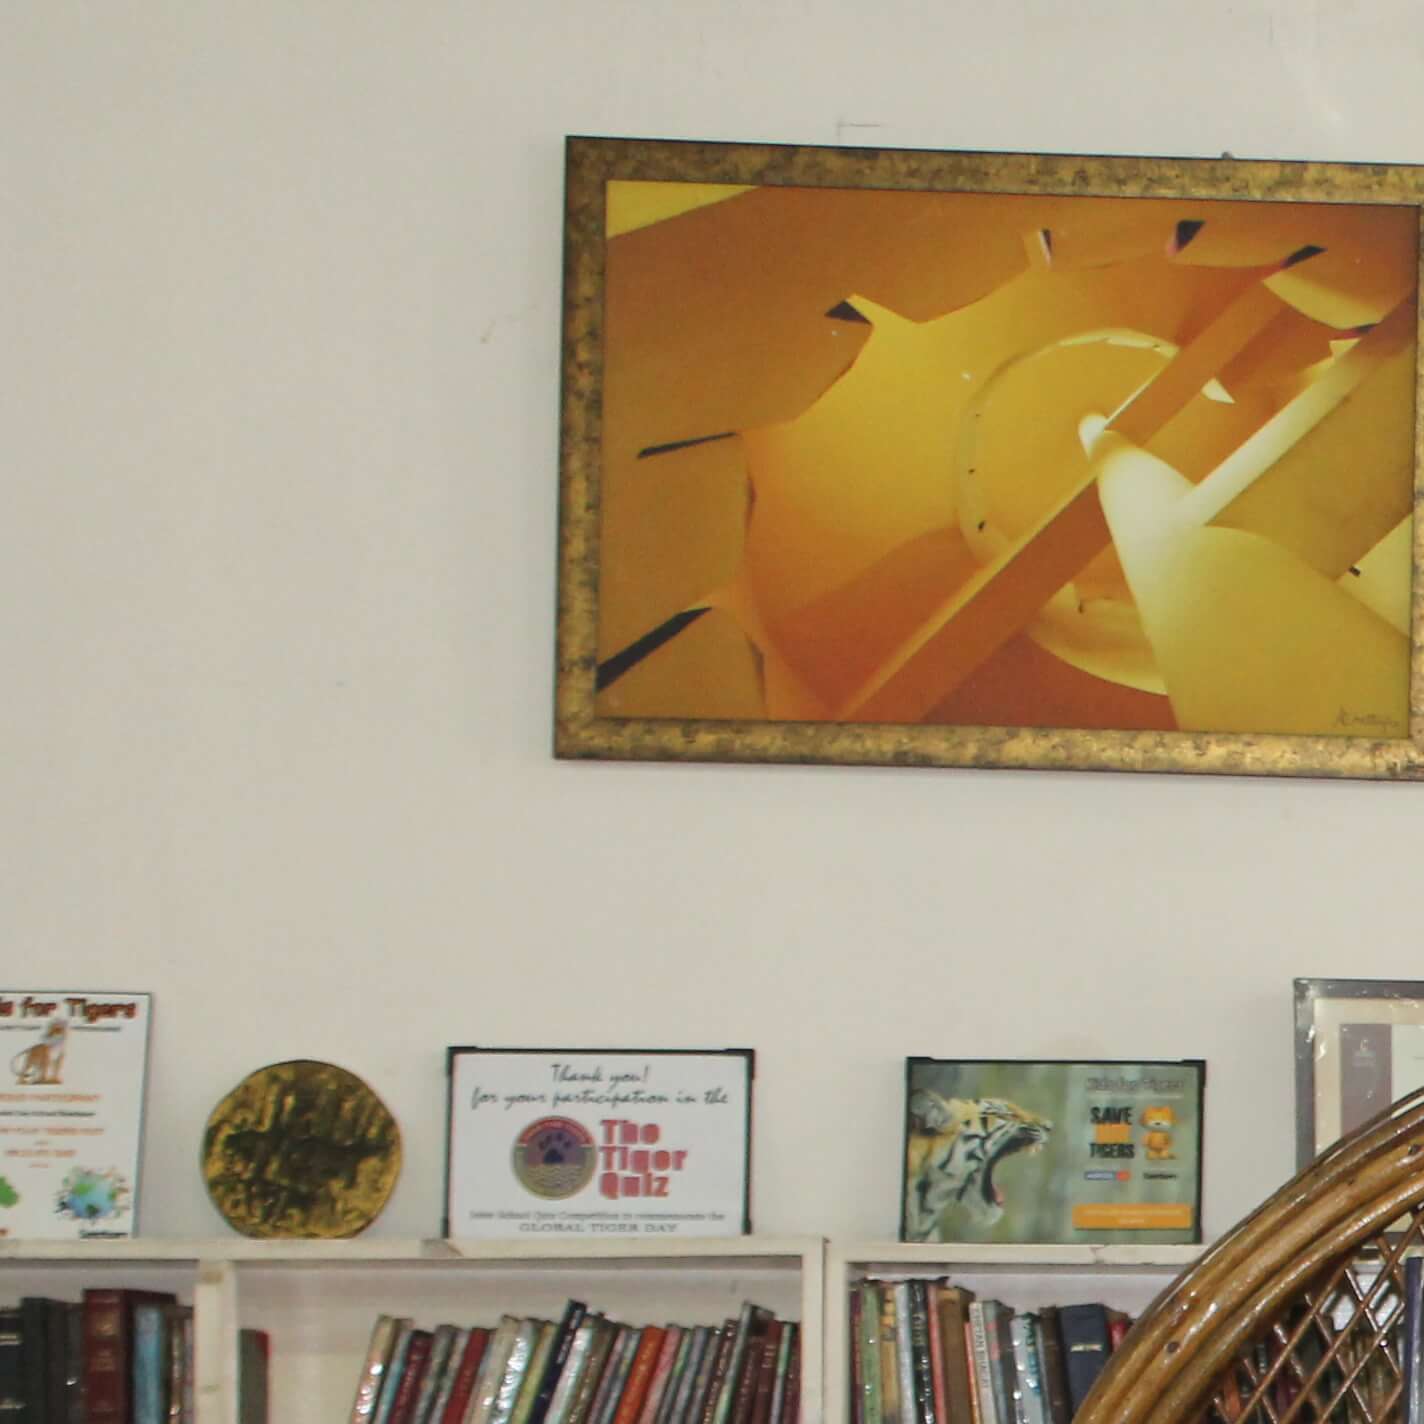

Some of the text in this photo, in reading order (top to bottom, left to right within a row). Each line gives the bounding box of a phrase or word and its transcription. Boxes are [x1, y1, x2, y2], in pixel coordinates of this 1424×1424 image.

[20, 996, 57, 1018] for
[64, 997, 136, 1025] Tigers
[551, 1064, 650, 1090] Thank you!
[470, 1085, 729, 1111] for your participation in the
[1089, 1106, 1134, 1125] SAVE
[600, 1118, 661, 1145] The
[598, 1145, 688, 1173] Tiger
[599, 1171, 670, 1200] Quiz
[518, 1222, 678, 1233] GLOBAL TIGER DAY
